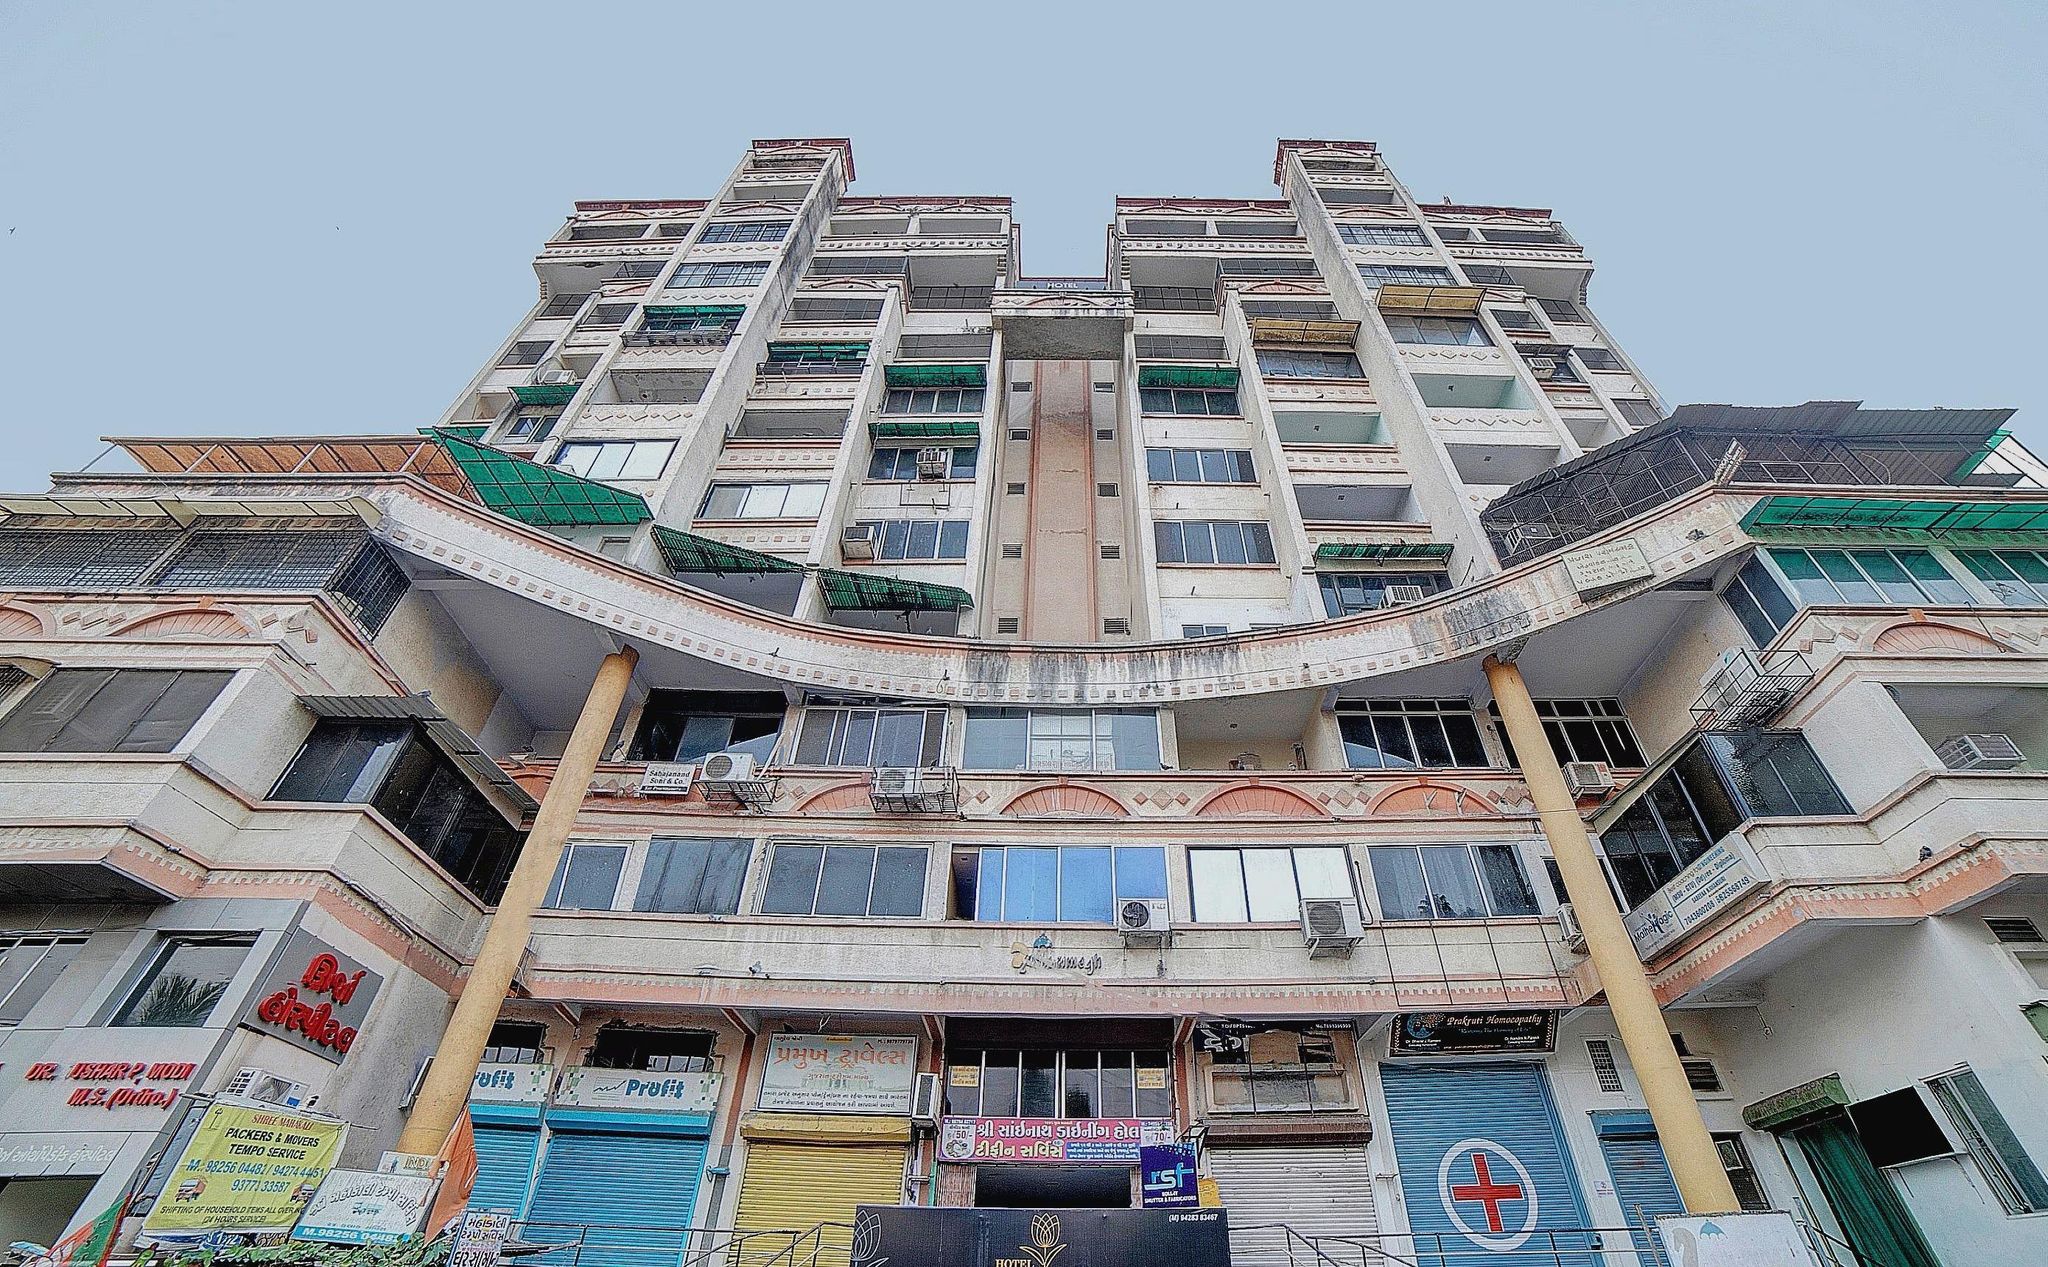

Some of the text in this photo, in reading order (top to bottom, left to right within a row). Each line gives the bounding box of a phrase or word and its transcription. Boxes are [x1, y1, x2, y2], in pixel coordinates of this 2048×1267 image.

[648, 769, 690, 778] Sahajanand
[1447, 1015, 1483, 1026] Prakruti
[773, 1041, 907, 1069] પ્રમુખ ટ્રાવેલ્સ
[24, 1062, 58, 1081] DR.
[145, 1062, 197, 1081] MODI
[626, 1079, 685, 1099] Profit
[251, 1113, 278, 1126] SHREE
[224, 1127, 321, 1148] PACKERS & MOVERS
[976, 1120, 994, 1138] શ્રી
[997, 1120, 1053, 1138] સાંઈનાથ
[1113, 1121, 1140, 1140] હોલ
[228, 1143, 307, 1160] TEMPO SERVICE
[975, 1139, 1063, 1158] ટીફીન સર્વિસ
[205, 1160, 237, 1174] 98256
[1144, 1162, 1194, 1191] rsf
[160, 1205, 193, 1214] SHIFTING
[194, 1206, 205, 1214] OF
[205, 1206, 246, 1214] HOUSEHOLD
[995, 1258, 1032, 1267] HOTEL
